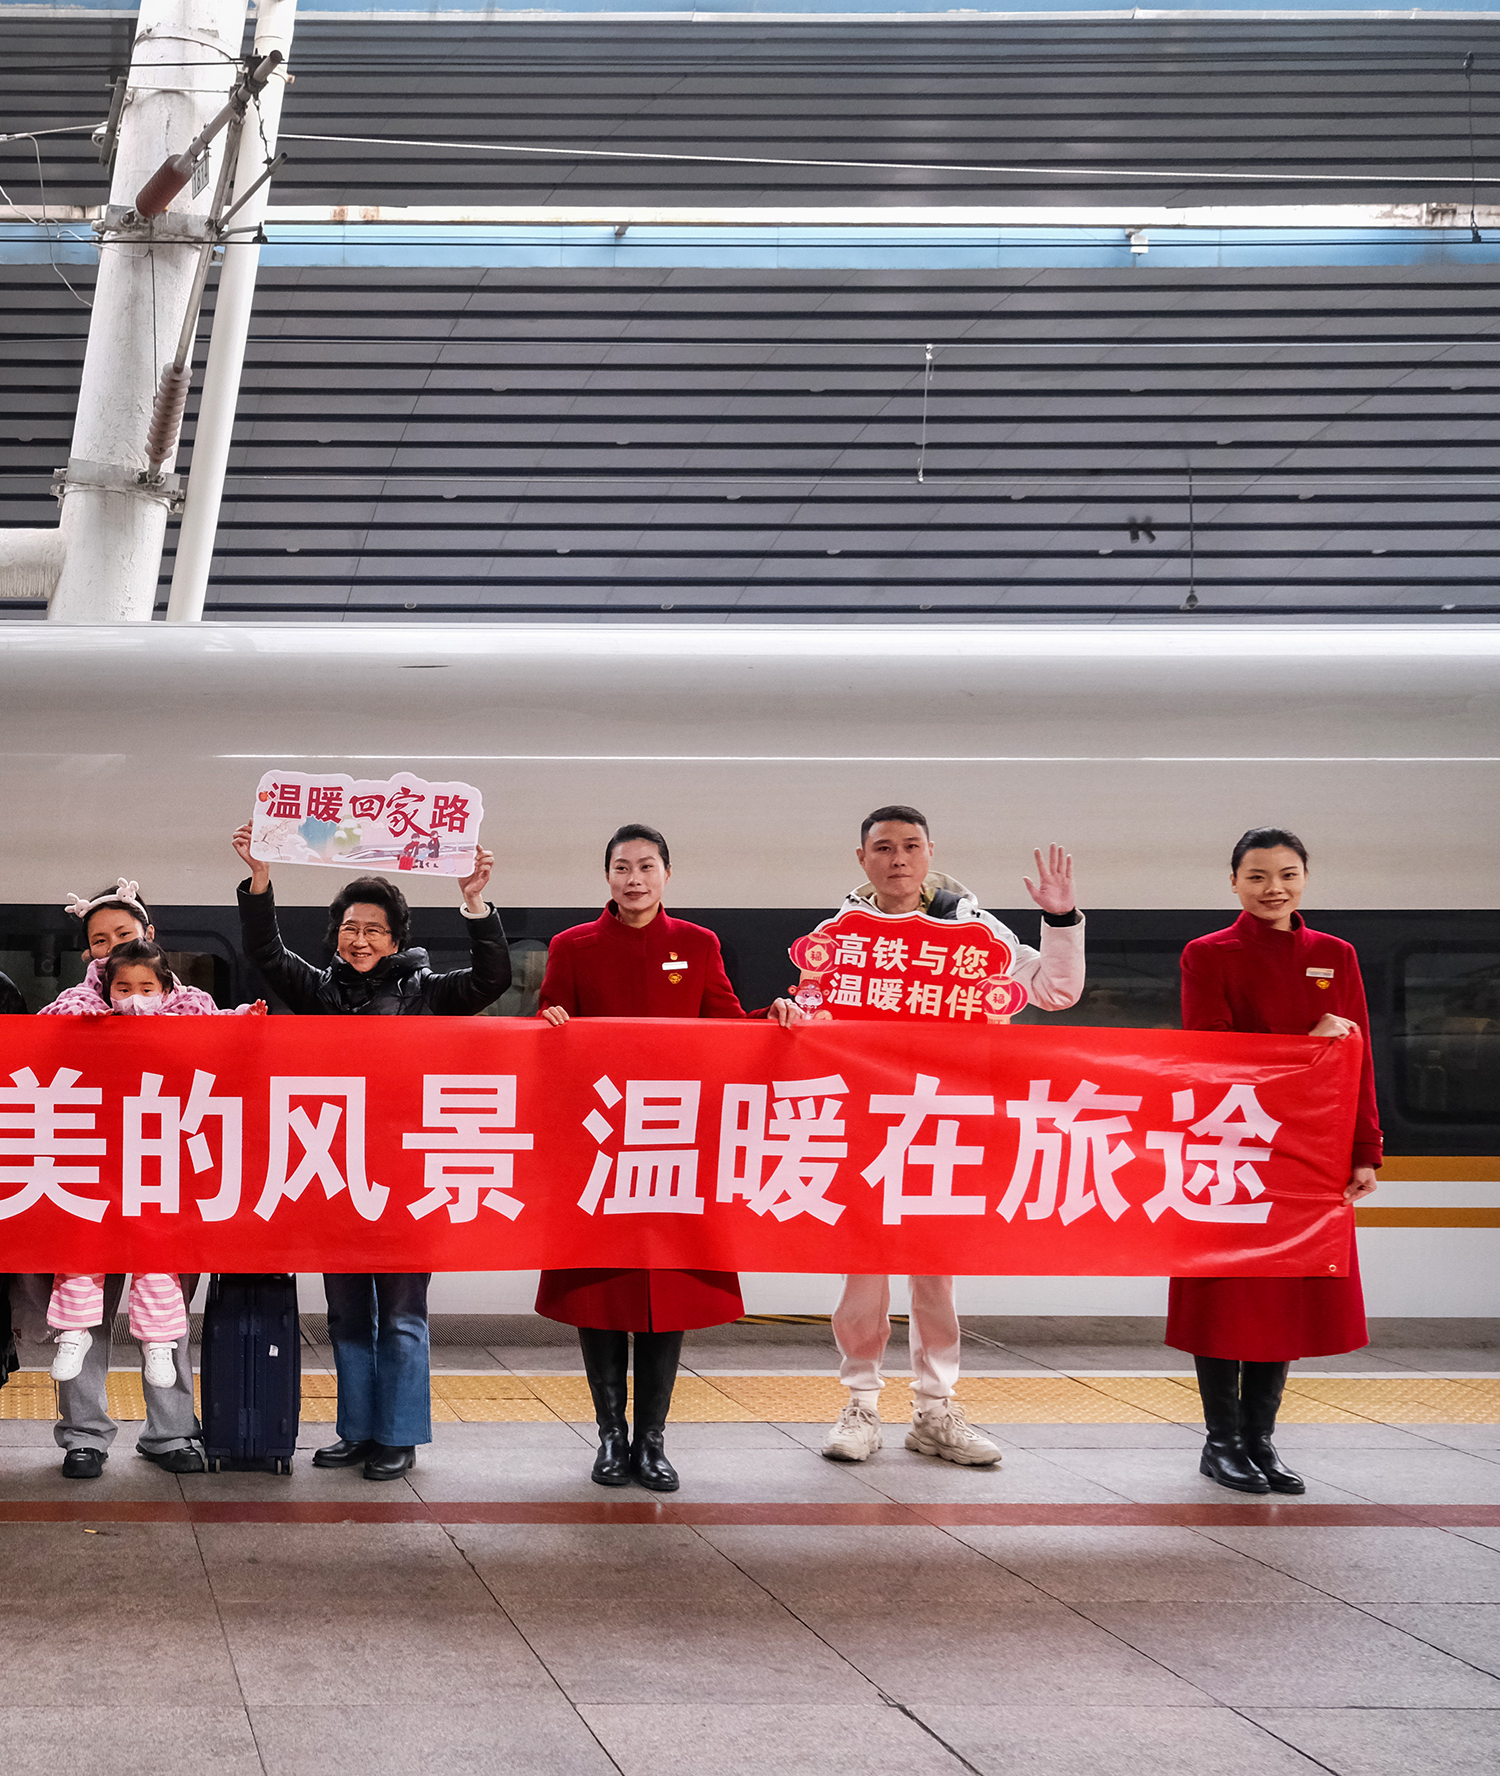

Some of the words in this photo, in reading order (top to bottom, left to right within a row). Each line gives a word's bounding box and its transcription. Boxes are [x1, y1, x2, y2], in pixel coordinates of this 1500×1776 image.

[266, 783, 470, 838] 温暖回家路
[834, 933, 990, 980] 高铁与您
[826, 972, 985, 1021] 温暖相伴
[576, 1073, 1283, 1227] 温暖在旅途
